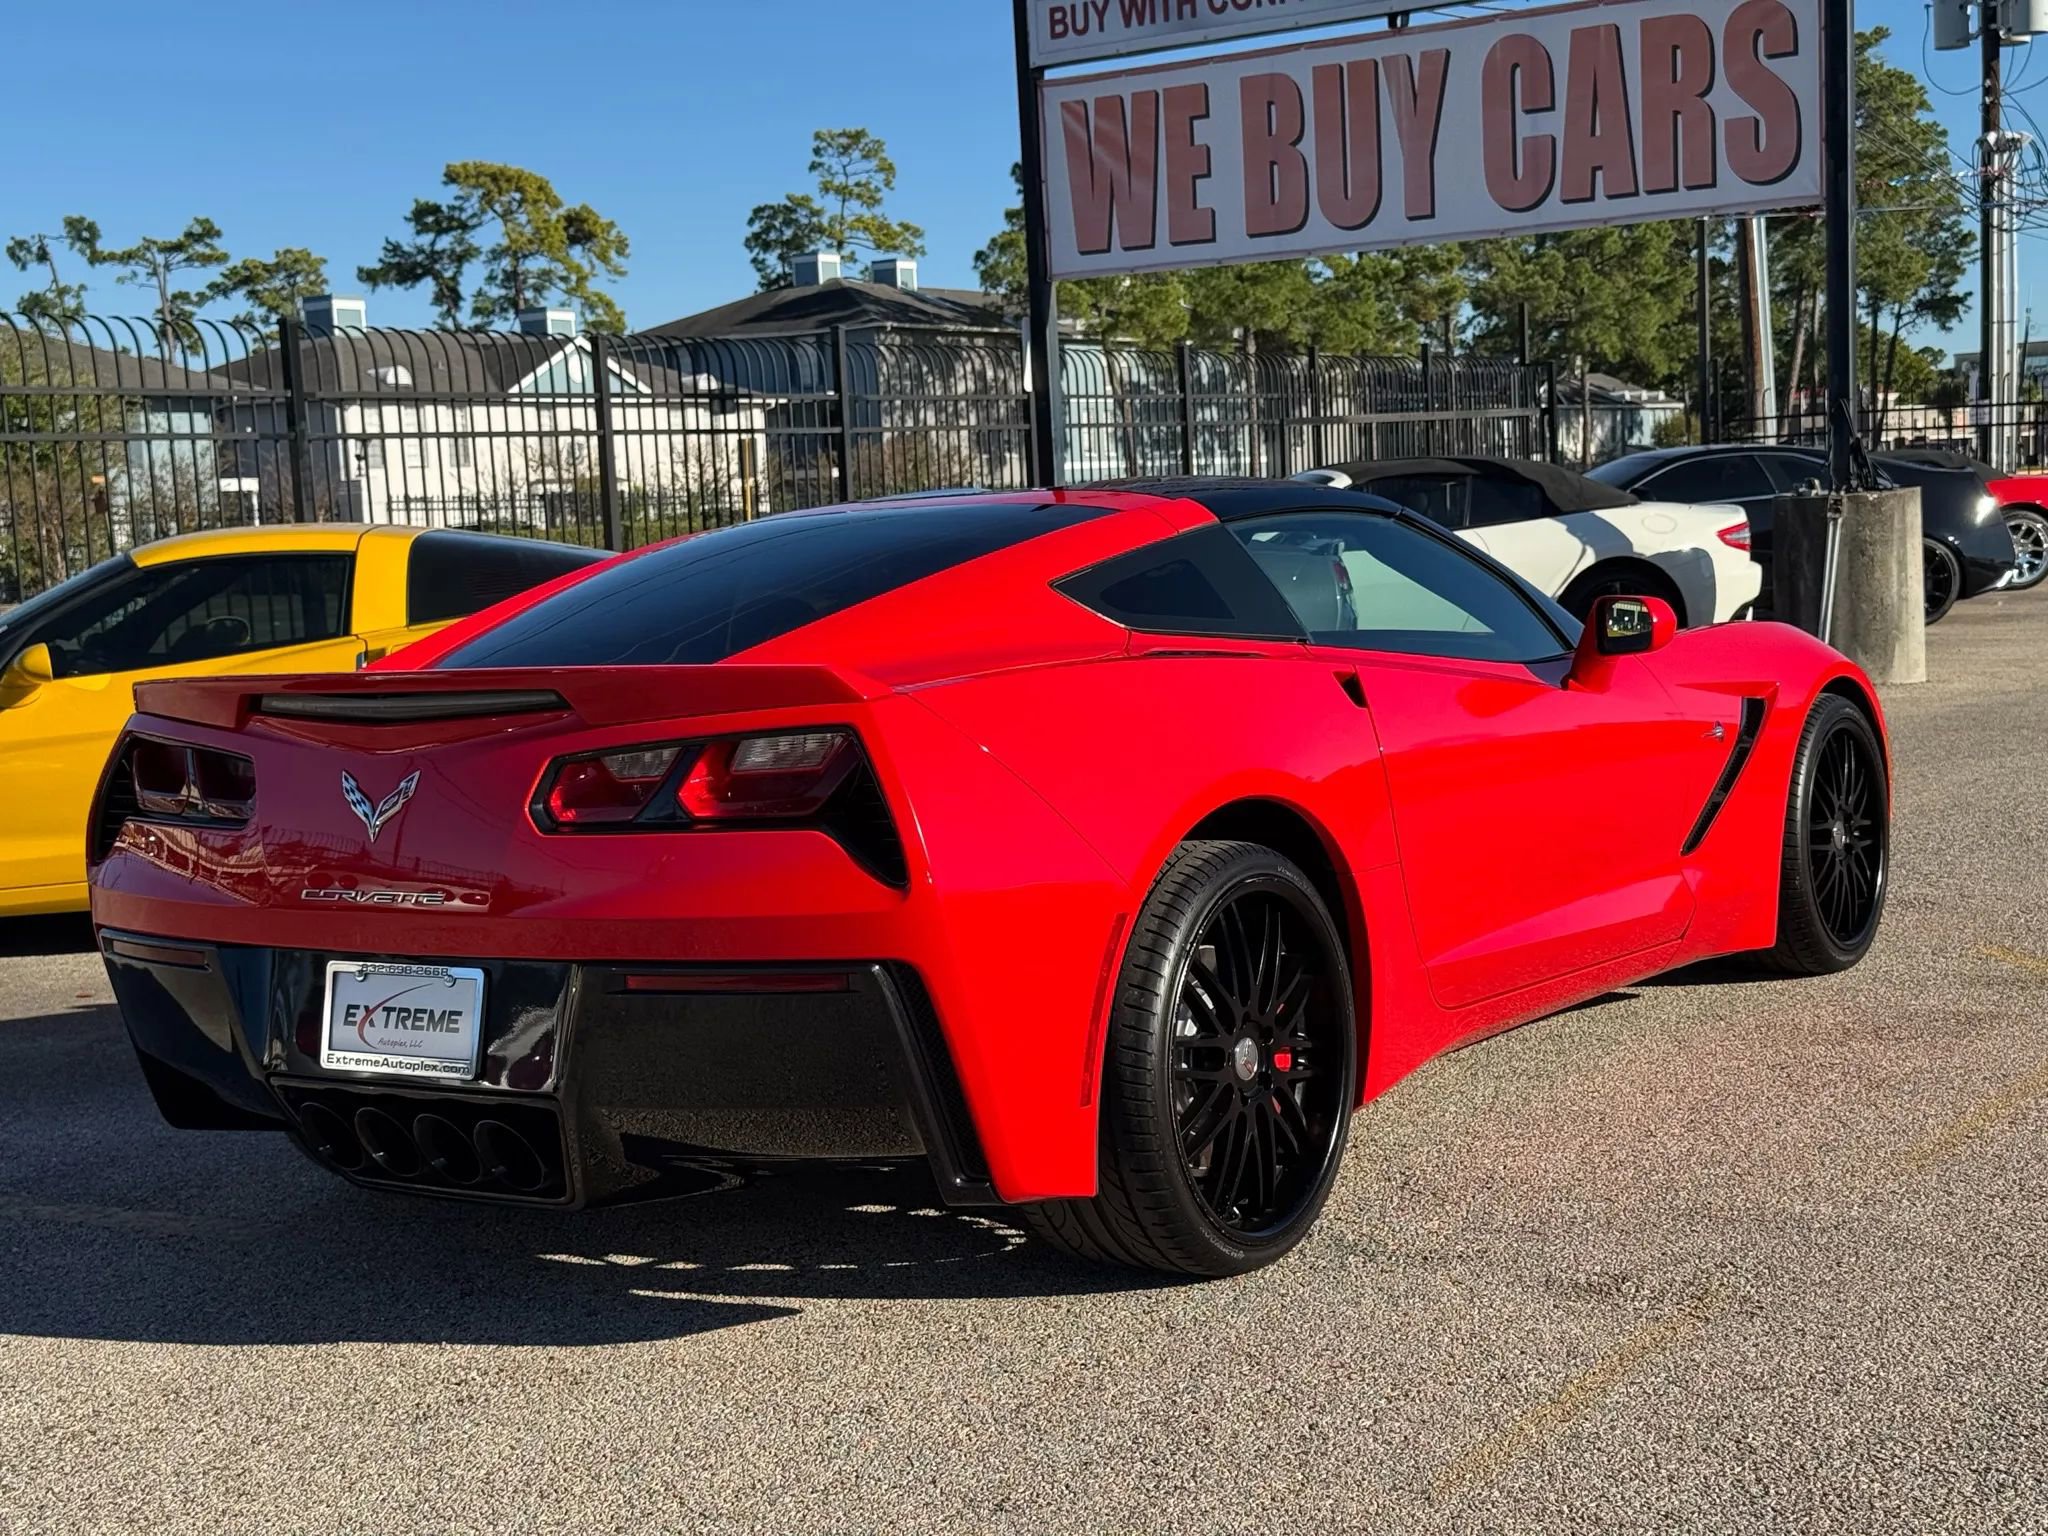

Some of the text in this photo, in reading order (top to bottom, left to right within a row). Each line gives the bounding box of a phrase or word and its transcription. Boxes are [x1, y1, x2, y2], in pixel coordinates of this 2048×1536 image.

[1049, 0, 1109, 40] BUY
[1060, 0, 1802, 256] WE BUY CARS
[343, 1003, 463, 1034] EXTREME
[409, 1039, 424, 1049] LLC
[326, 1053, 470, 1074] ExtremeAutoplex.com
